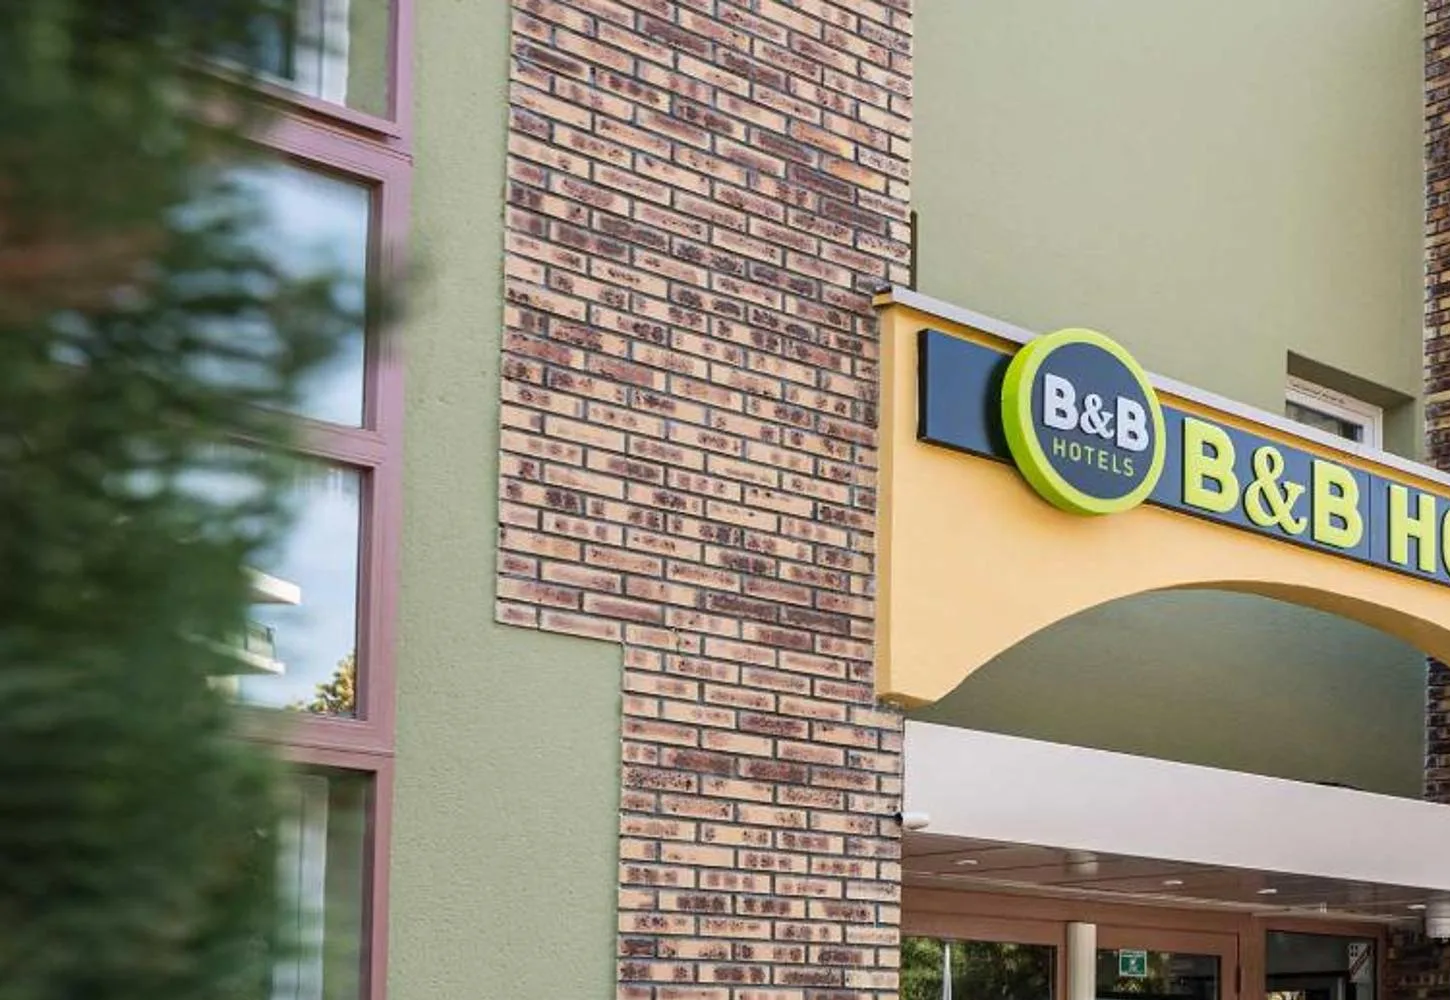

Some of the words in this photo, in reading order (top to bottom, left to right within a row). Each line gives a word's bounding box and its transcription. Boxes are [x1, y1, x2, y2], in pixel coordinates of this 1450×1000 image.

[1044, 373, 1149, 451] B&B
[1053, 437, 1135, 477] HOTELS
[1183, 416, 1363, 548] B&B
